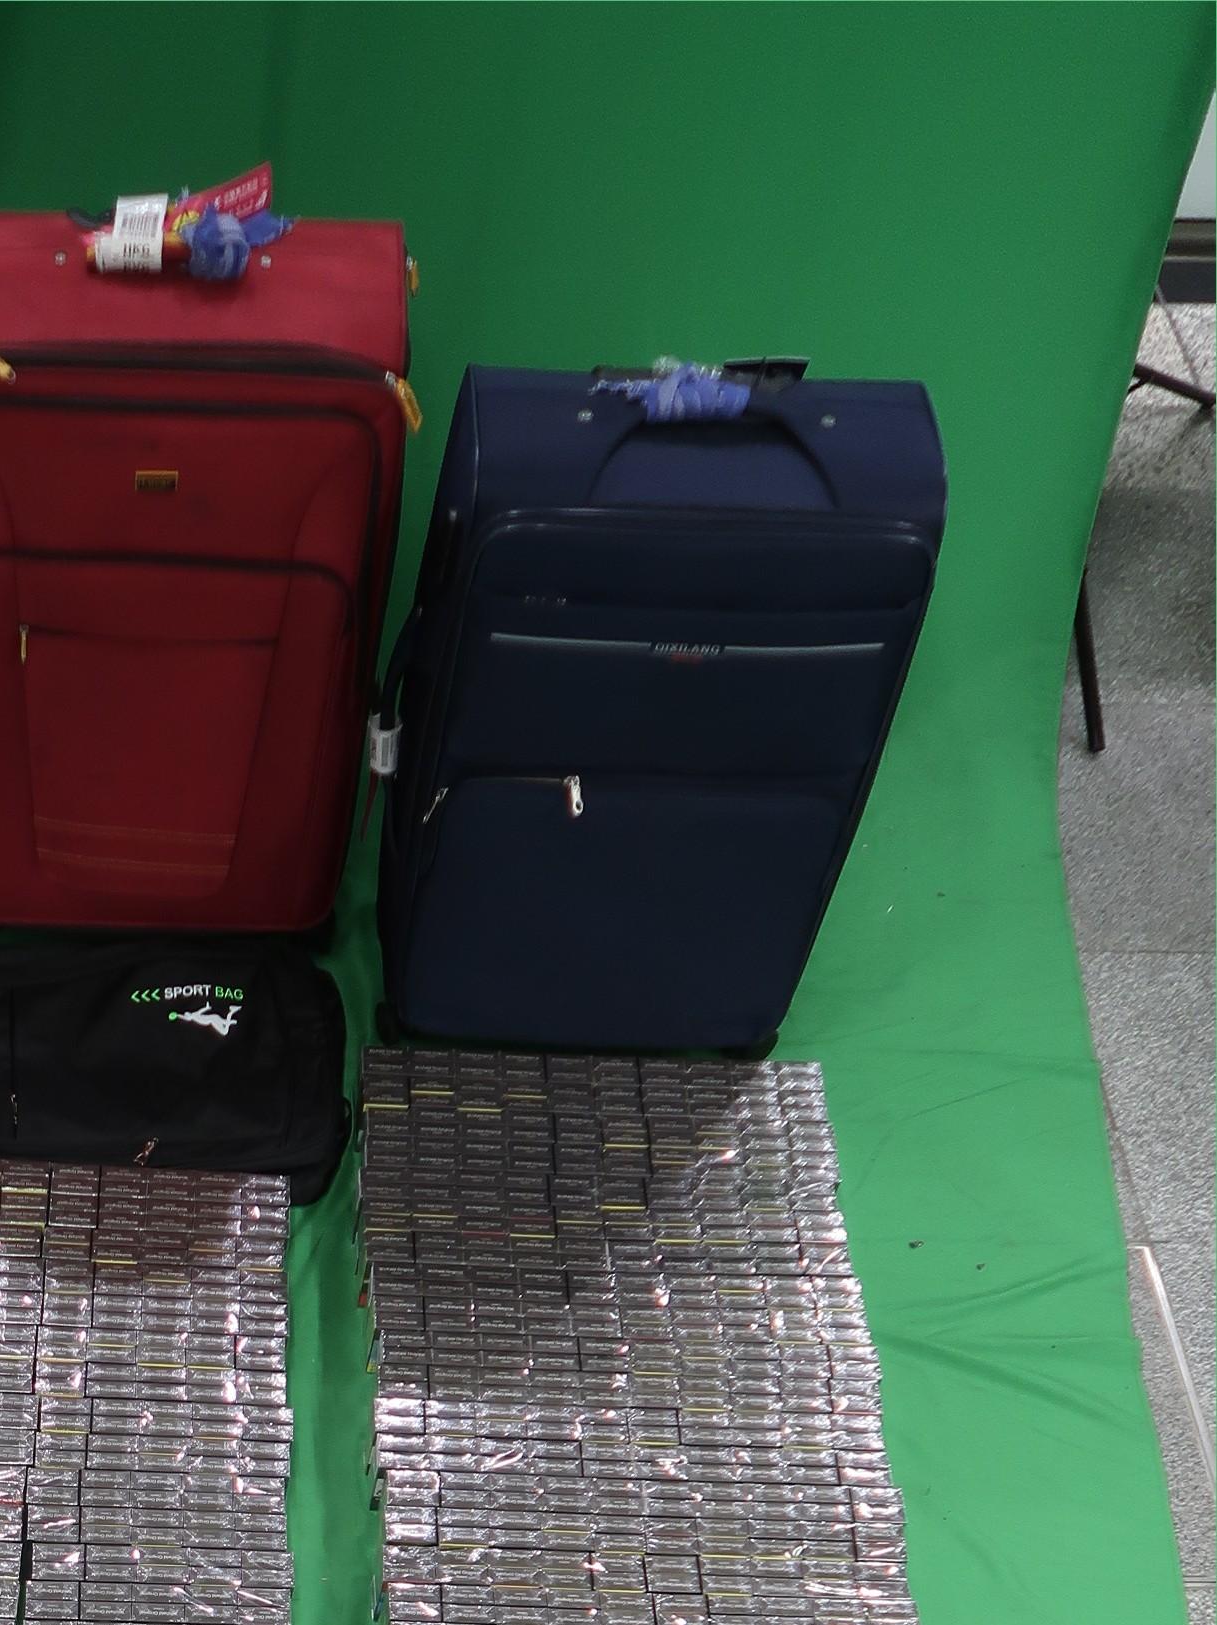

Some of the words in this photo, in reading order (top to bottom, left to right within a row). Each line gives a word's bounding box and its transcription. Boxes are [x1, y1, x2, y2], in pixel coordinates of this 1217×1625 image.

[123, 243, 150, 257] HKG
[164, 984, 211, 999] SPORT
[215, 986, 244, 1000] BAG
